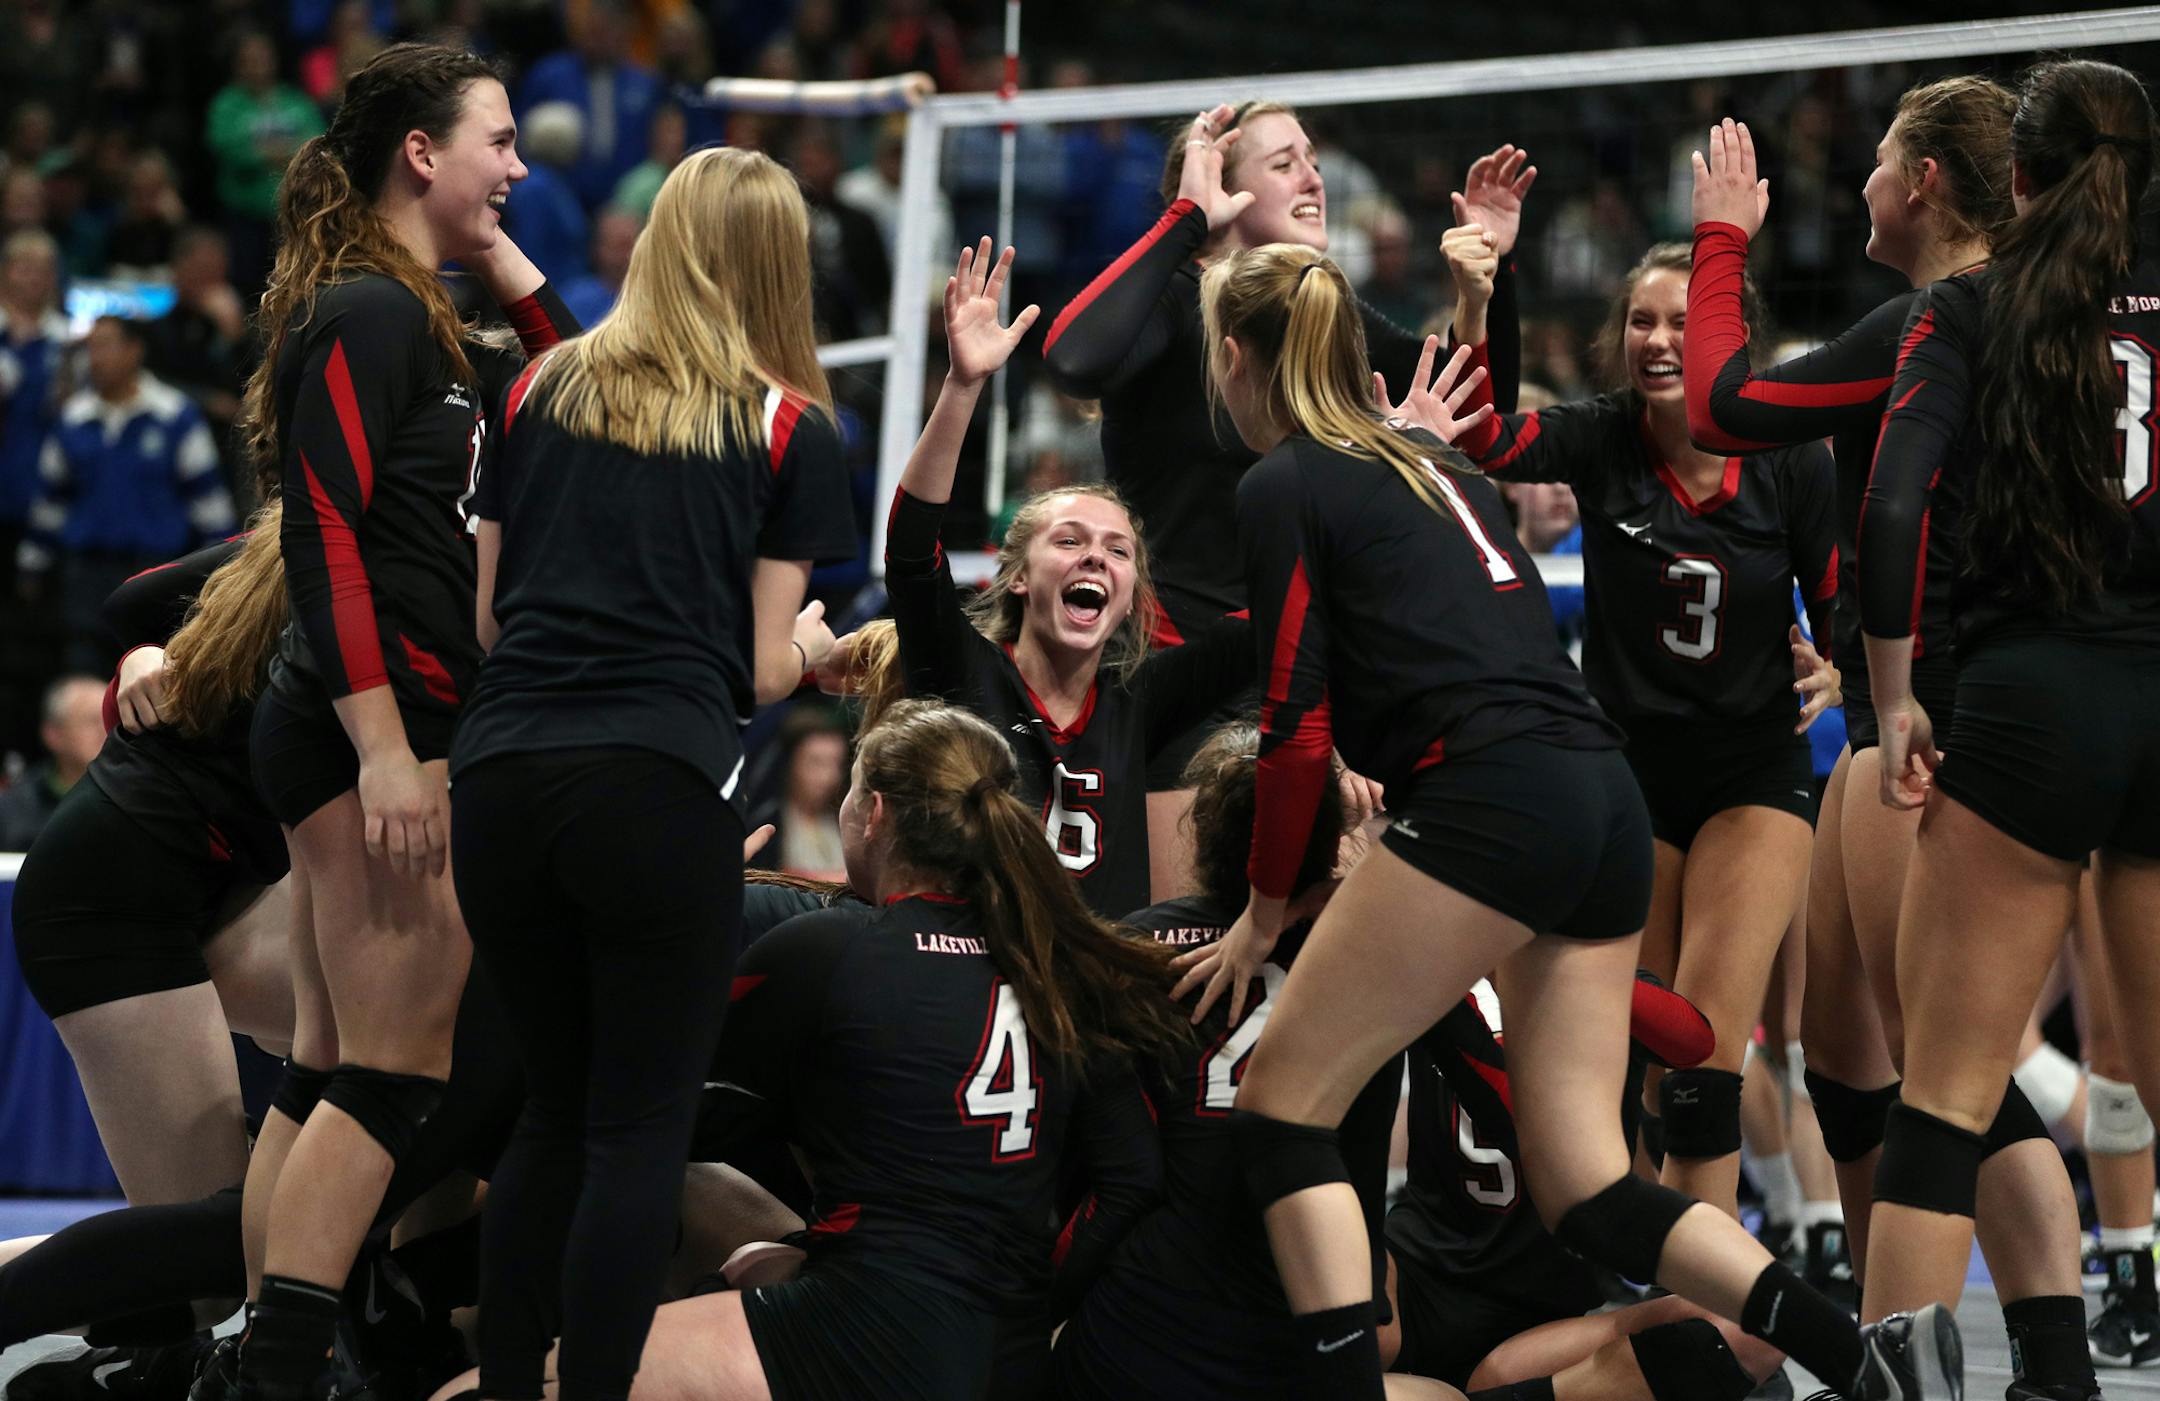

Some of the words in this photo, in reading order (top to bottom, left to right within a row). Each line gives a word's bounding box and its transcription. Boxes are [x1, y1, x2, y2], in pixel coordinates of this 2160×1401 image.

[1660, 556, 1725, 662] 3
[1045, 760, 1101, 873] 6
[961, 980, 1040, 1156] 4
[1457, 1101, 1518, 1209] 5
